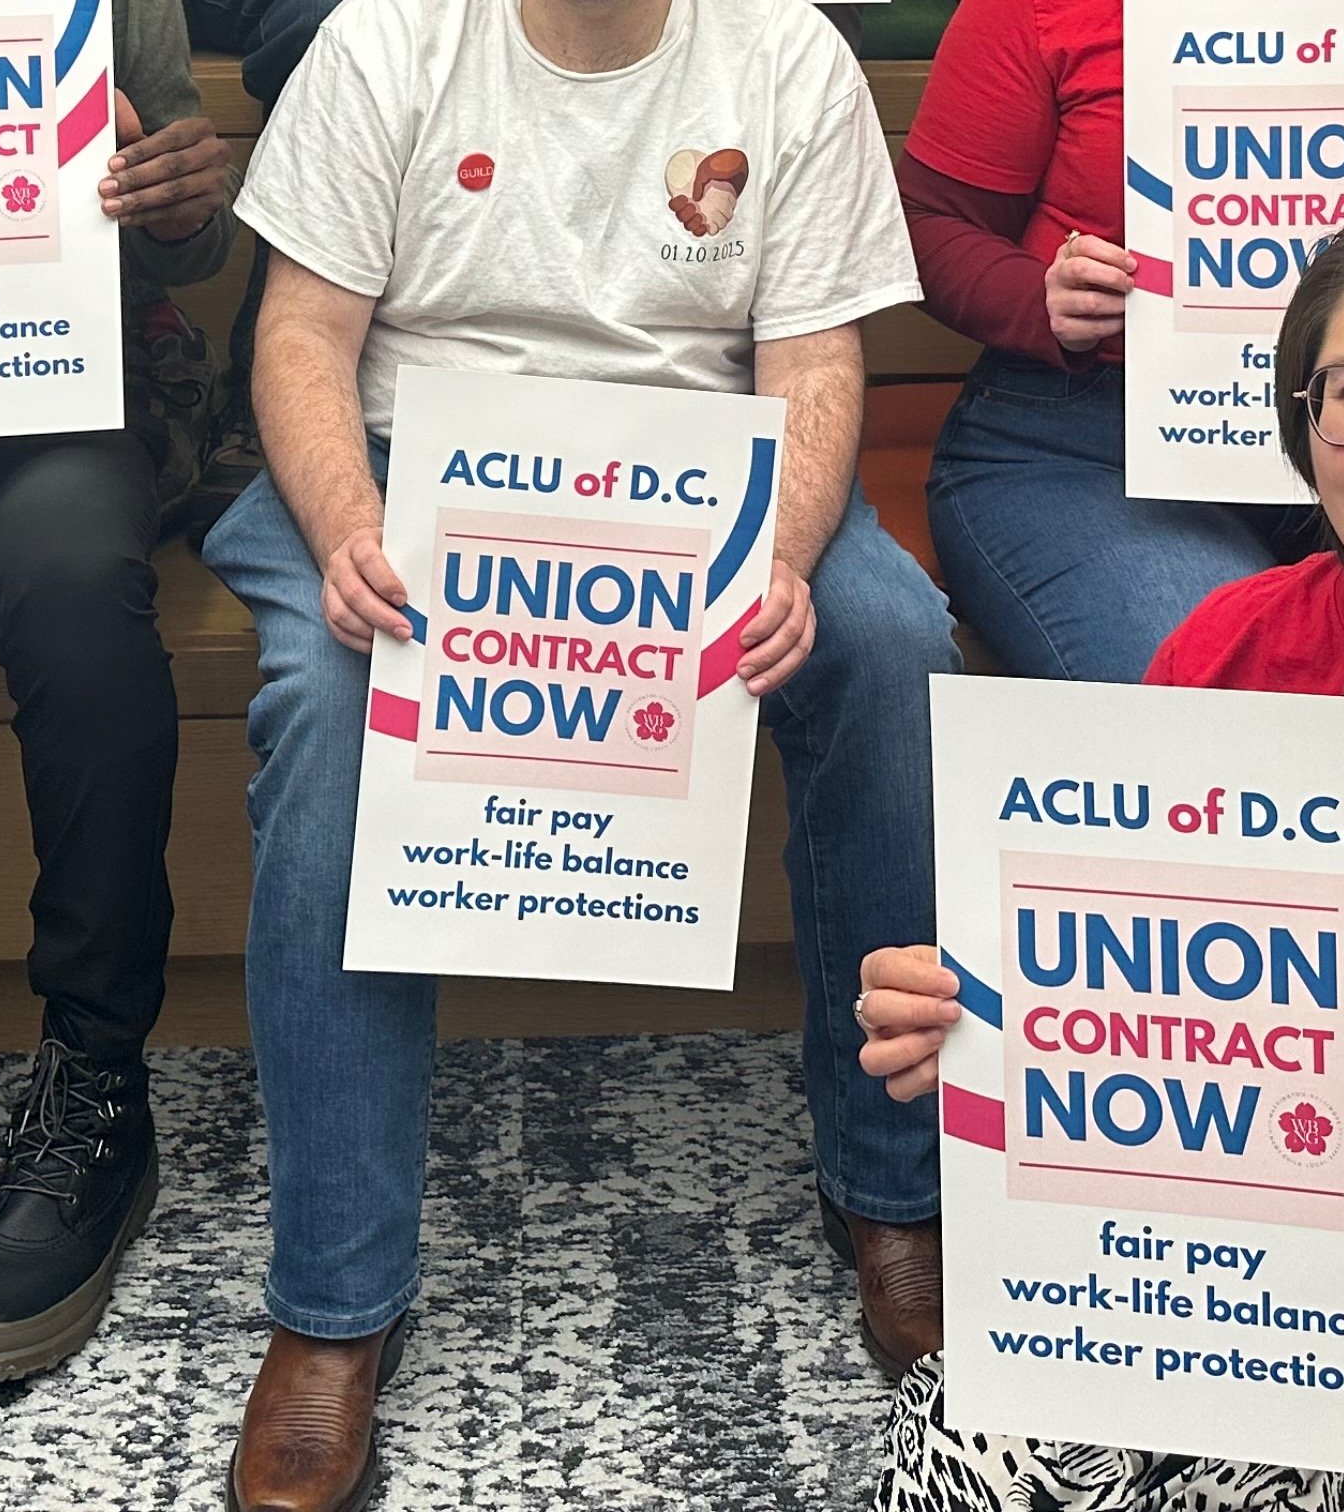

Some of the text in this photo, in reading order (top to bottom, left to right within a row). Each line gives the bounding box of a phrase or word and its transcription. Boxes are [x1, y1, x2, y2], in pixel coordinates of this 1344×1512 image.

[1173, 32, 1285, 65] ACLU
[1297, 29, 1337, 64] of
[459, 166, 493, 179] GUILD
[1158, 420, 1272, 446] worker
[440, 450, 718, 508] ACLU of D.C.
[444, 552, 694, 633] UNION
[442, 627, 684, 682] CONTRACT
[436, 675, 624, 743] NOW
[484, 795, 614, 839] fair pay
[999, 777, 1150, 830] ACLU
[1168, 788, 1226, 835] of
[403, 838, 689, 881] work-life balance
[387, 881, 699, 925] worker protections
[1018, 908, 1338, 1010] UNION
[1023, 1007, 1335, 1075] CONTRACT
[1025, 1068, 1262, 1156] NOW
[1100, 1221, 1267, 1281] fair pay
[1002, 1273, 1194, 1319] work-life
[989, 1326, 1144, 1367] worker
